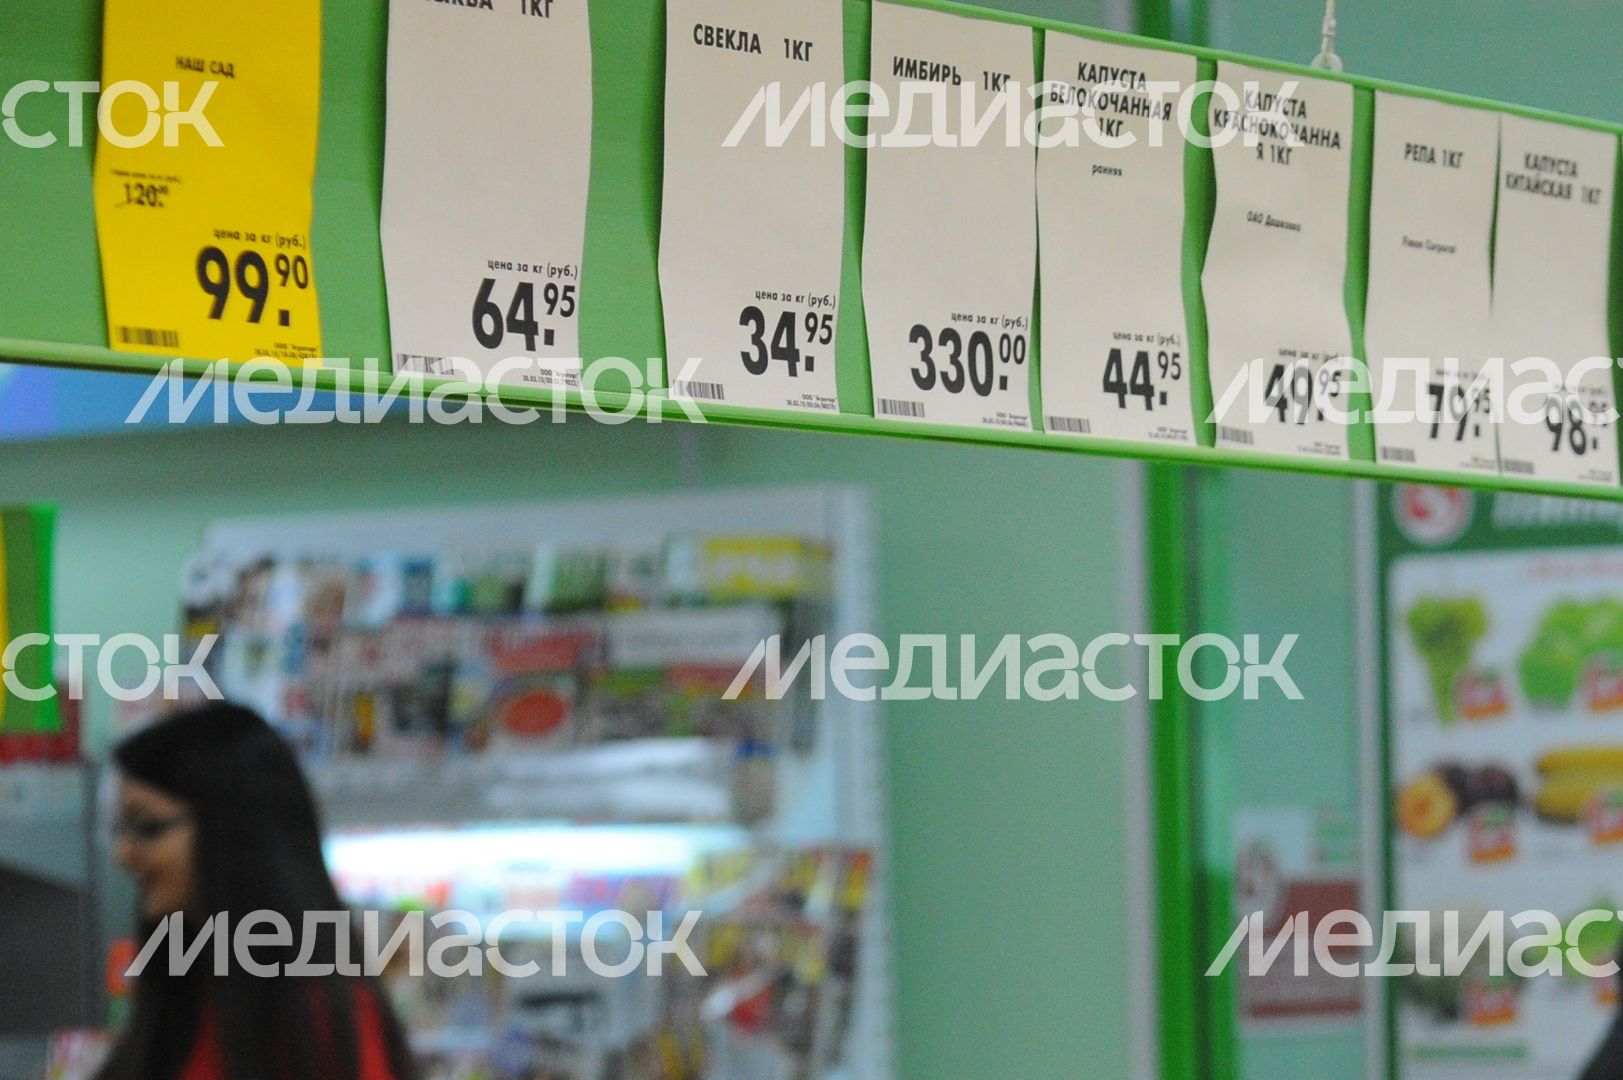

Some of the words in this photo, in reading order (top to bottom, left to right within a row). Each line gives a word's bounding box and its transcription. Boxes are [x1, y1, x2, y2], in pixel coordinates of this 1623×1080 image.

[693, 23, 762, 54] СВЕКЛА
[784, 38, 813, 62] 1КГ
[175, 55, 205, 73] НАШ
[209, 61, 236, 79] САД
[893, 56, 962, 86] ИМБИРЬ
[983, 71, 1011, 93] 1КГ
[1077, 62, 1147, 91] КАПУСТА
[1050, 83, 1173, 121] БЕЛОКОЧАННАЯ
[1245, 89, 1307, 119] КАПУСТА
[1099, 117, 1124, 138] 1КГ
[1213, 109, 1341, 149] КРАСНОКОЧАННА
[1271, 144, 1293, 165] 1КГ
[1405, 142, 1436, 164] РЕПА
[1442, 149, 1464, 168] 1КГ
[1524, 152, 1578, 177] КАПУСТА
[214, 229, 240, 240] цена
[245, 231, 256, 242] за
[261, 233, 271, 244] кг
[488, 259, 513, 271] цена
[517, 262, 529, 273] за
[533, 264, 543, 274] кг
[547, 262, 578, 280] (руб.)
[195, 245, 309, 327] 99.90
[755, 290, 778, 301] цена
[781, 292, 792, 302] за
[795, 294, 805, 304] кг
[808, 292, 836, 309] (руб.)
[472, 278, 576, 352] 64.95
[951, 312, 973, 323] цена
[976, 314, 987, 324] за
[990, 315, 999, 325] кг
[739, 306, 834, 377] 34.95
[909, 324, 1026, 397] 330.00
[1102, 348, 1182, 411] 44.95
